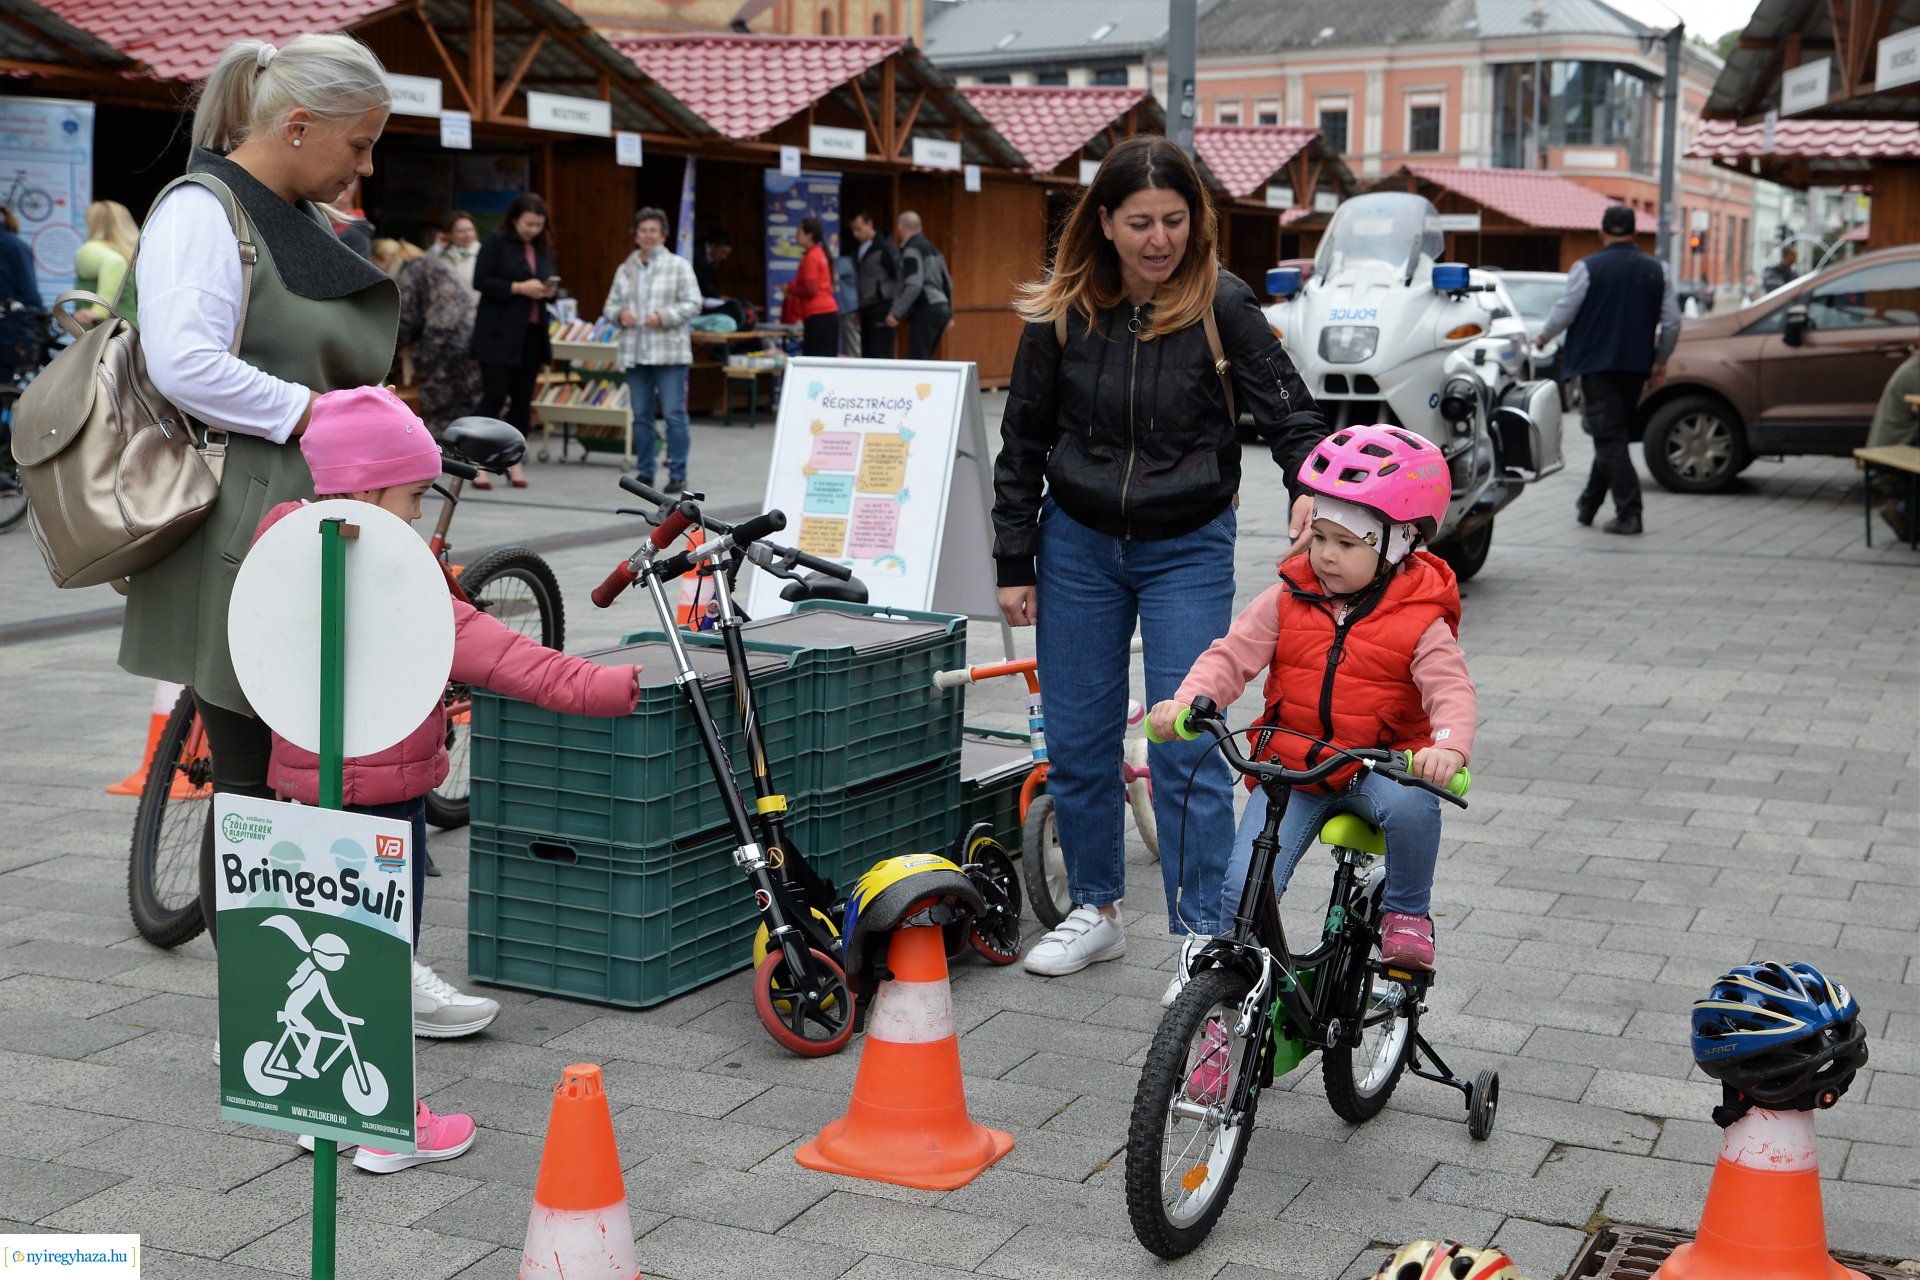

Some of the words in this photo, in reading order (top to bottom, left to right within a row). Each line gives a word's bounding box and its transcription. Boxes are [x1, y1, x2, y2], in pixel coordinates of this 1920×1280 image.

[822, 396, 913, 411] REGISZTRÁCIÓS
[843, 411, 886, 426] FAHÁZ
[222, 853, 405, 923] BringaSuli
[291, 1106, 347, 1125] WWW.ZOLDKERO.HU
